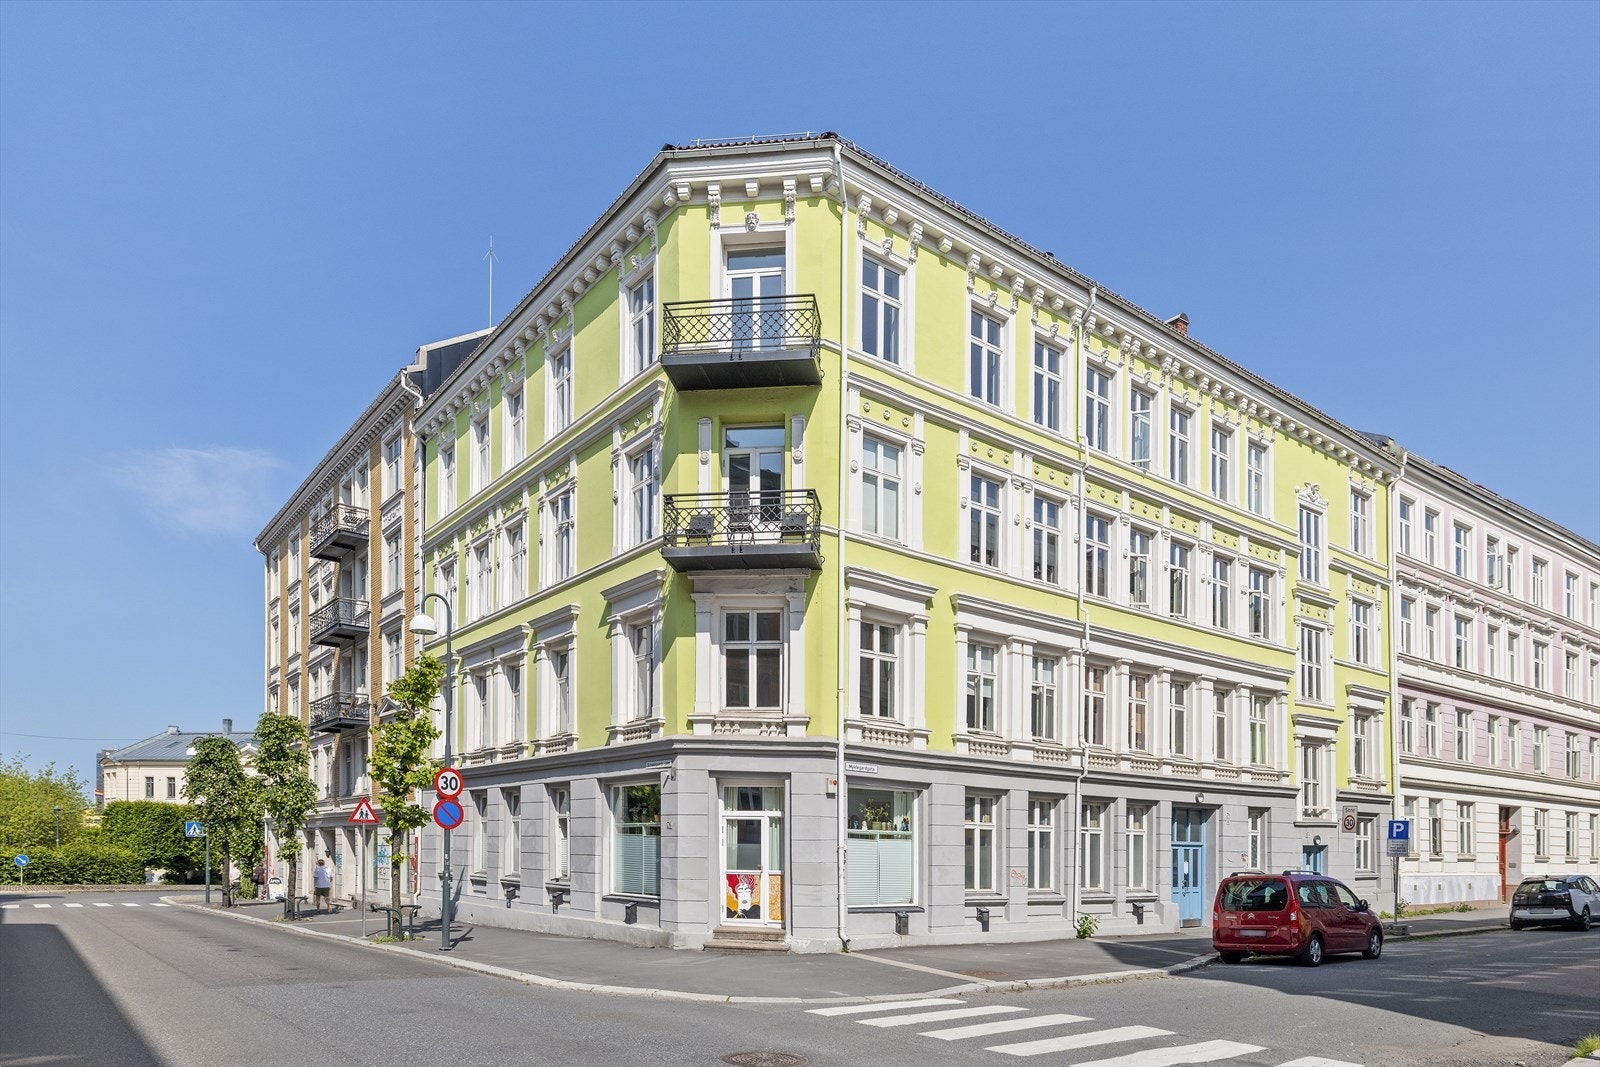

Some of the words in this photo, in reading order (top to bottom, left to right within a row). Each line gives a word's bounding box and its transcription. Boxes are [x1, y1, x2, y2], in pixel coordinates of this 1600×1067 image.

[440, 775, 458, 791] 30
[1346, 818, 1354, 827] 30
[1392, 822, 1405, 838] P
